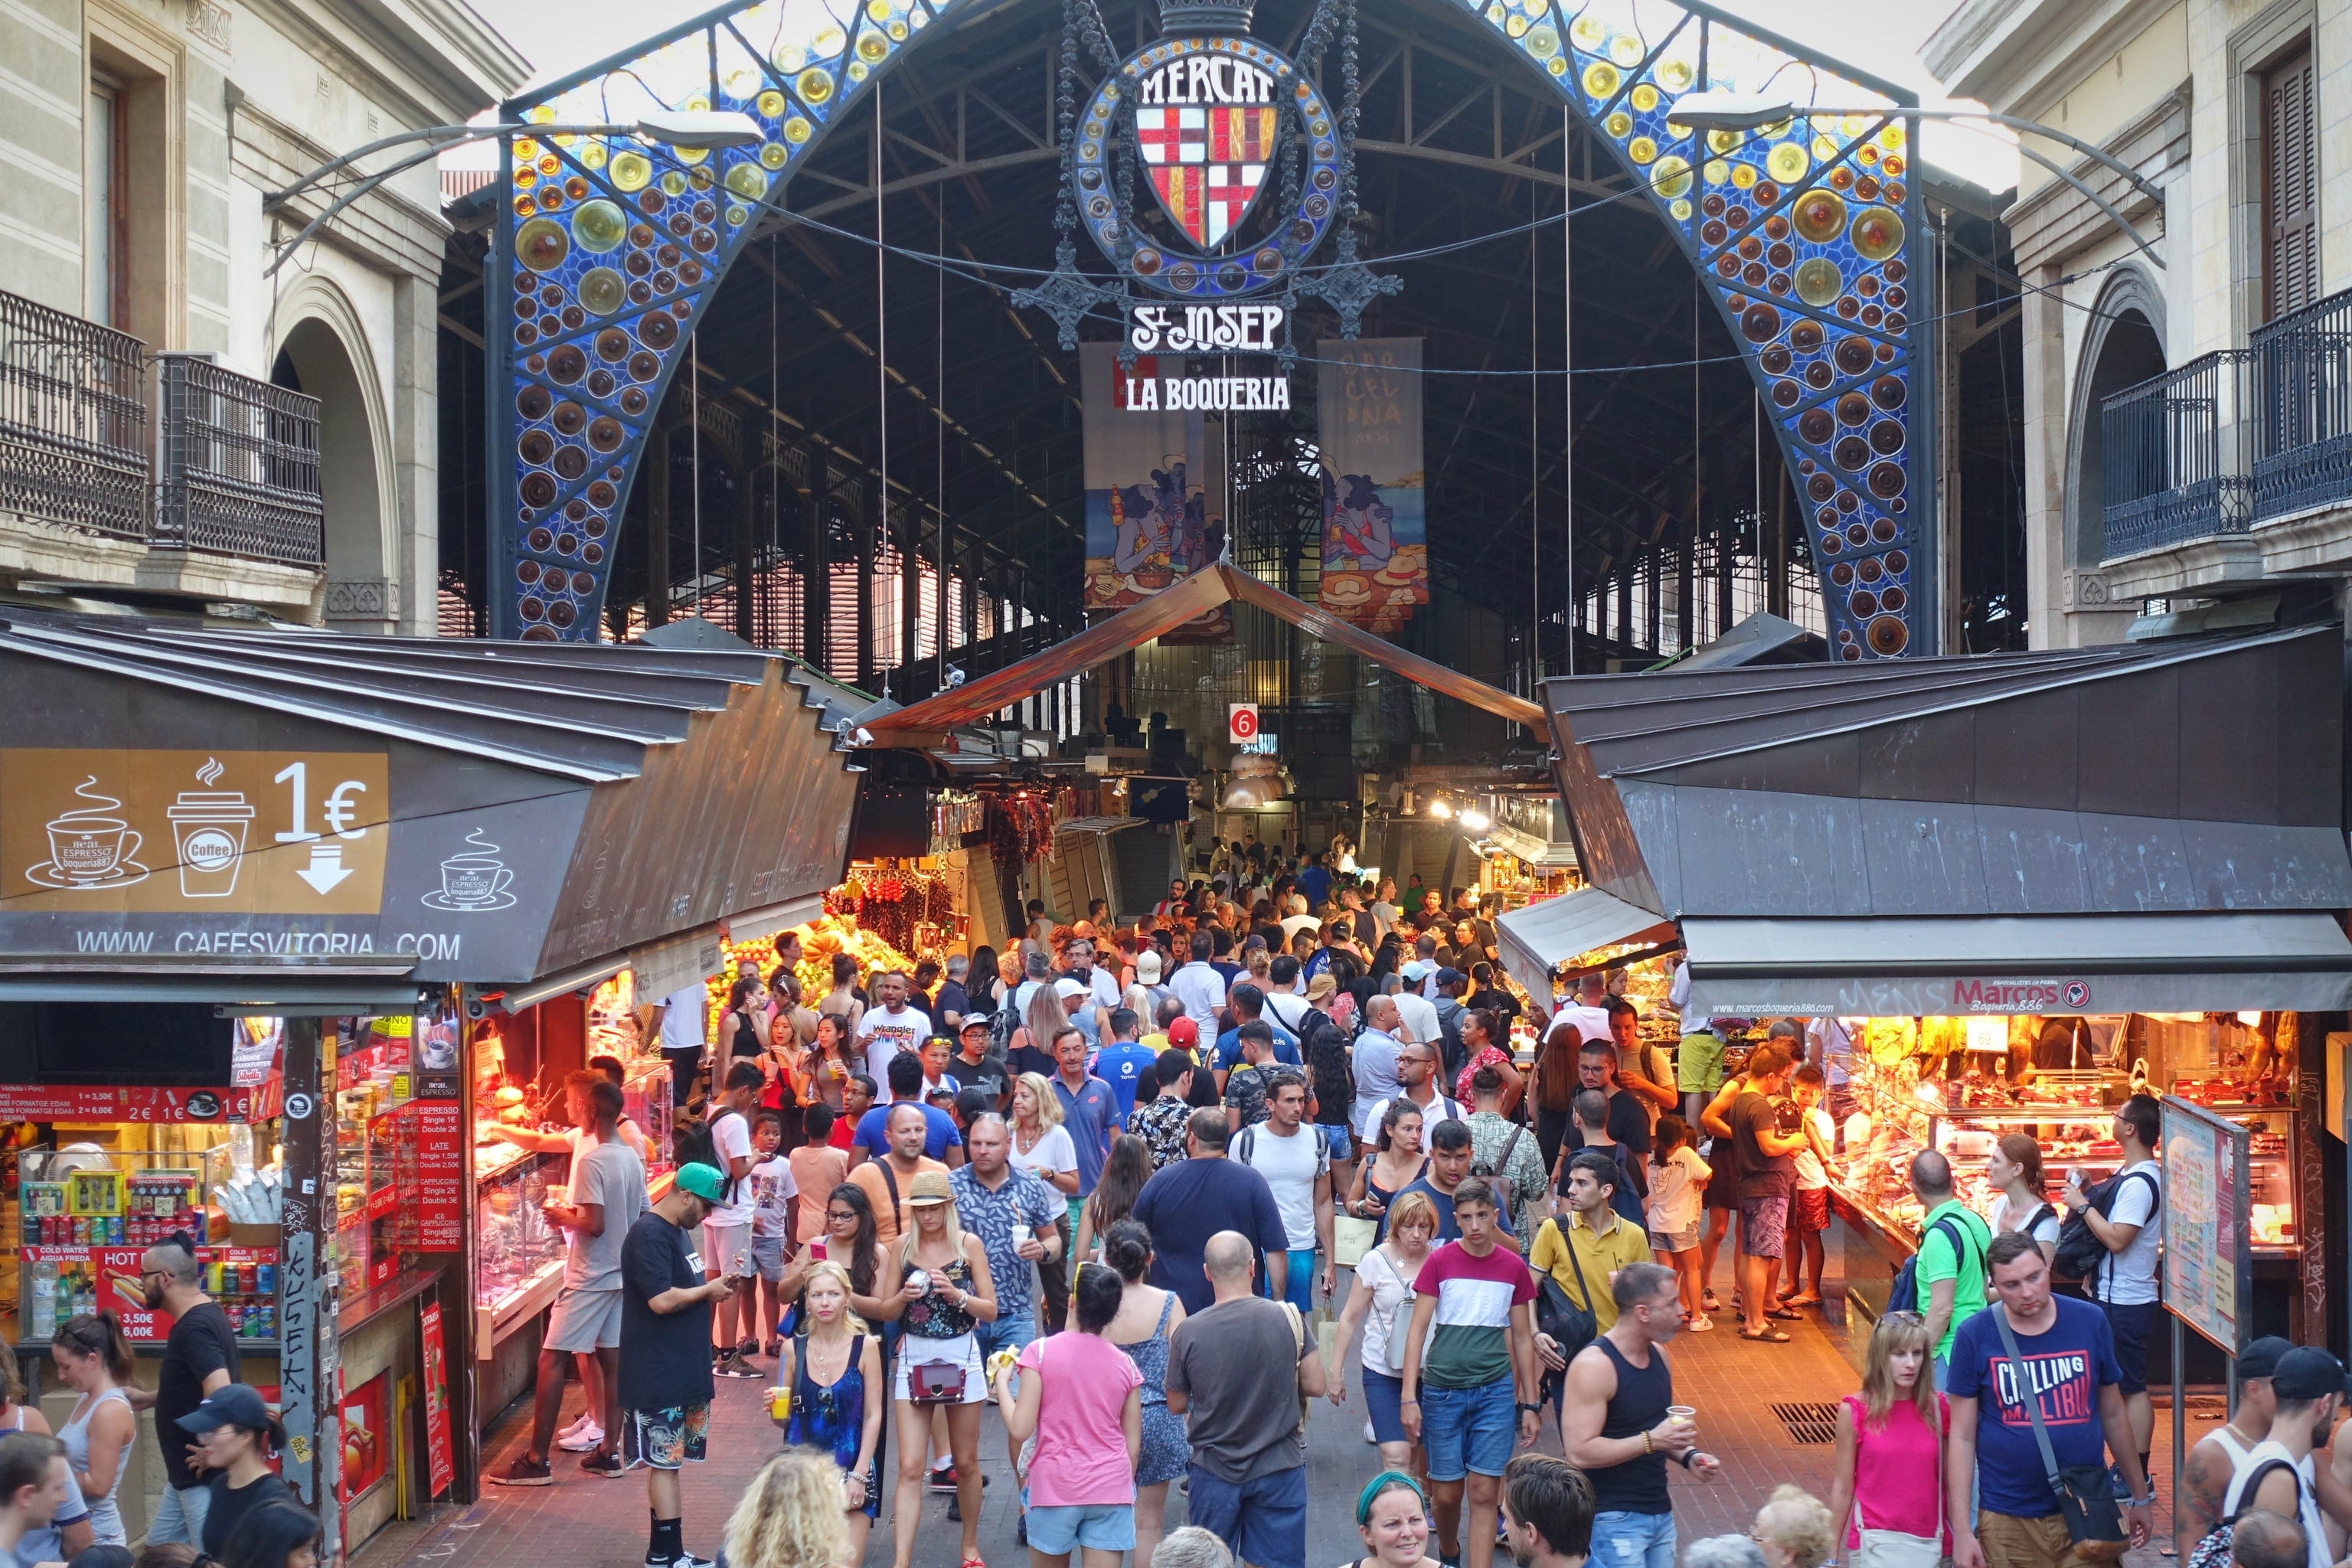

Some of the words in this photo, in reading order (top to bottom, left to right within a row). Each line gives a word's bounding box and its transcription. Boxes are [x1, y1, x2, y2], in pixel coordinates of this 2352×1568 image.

[1142, 56, 1274, 104] MERCAT
[1166, 306, 1283, 351] JOSEP
[1126, 378, 1158, 410] LA
[1165, 377, 1290, 410] BOQUERIA
[1238, 714, 1250, 733] 6
[64, 848, 112, 857] ESPRESSO
[191, 843, 230, 858] Coffee
[63, 858, 111, 869] boqueria887
[77, 932, 154, 952] WWW
[397, 933, 460, 960] COM
[1954, 980, 2059, 1005] Marcos
[391, 1016, 408, 1024] NO
[873, 1024, 916, 1037] Wrangler
[234, 1060, 271, 1069] FRANKFURTER
[236, 1069, 261, 1083] Sibylla
[92, 1093, 113, 1101] 3,50€
[105, 1253, 137, 1265] HOT
[123, 1313, 153, 1324] 3,50€
[123, 1327, 153, 1337] 6,00€
